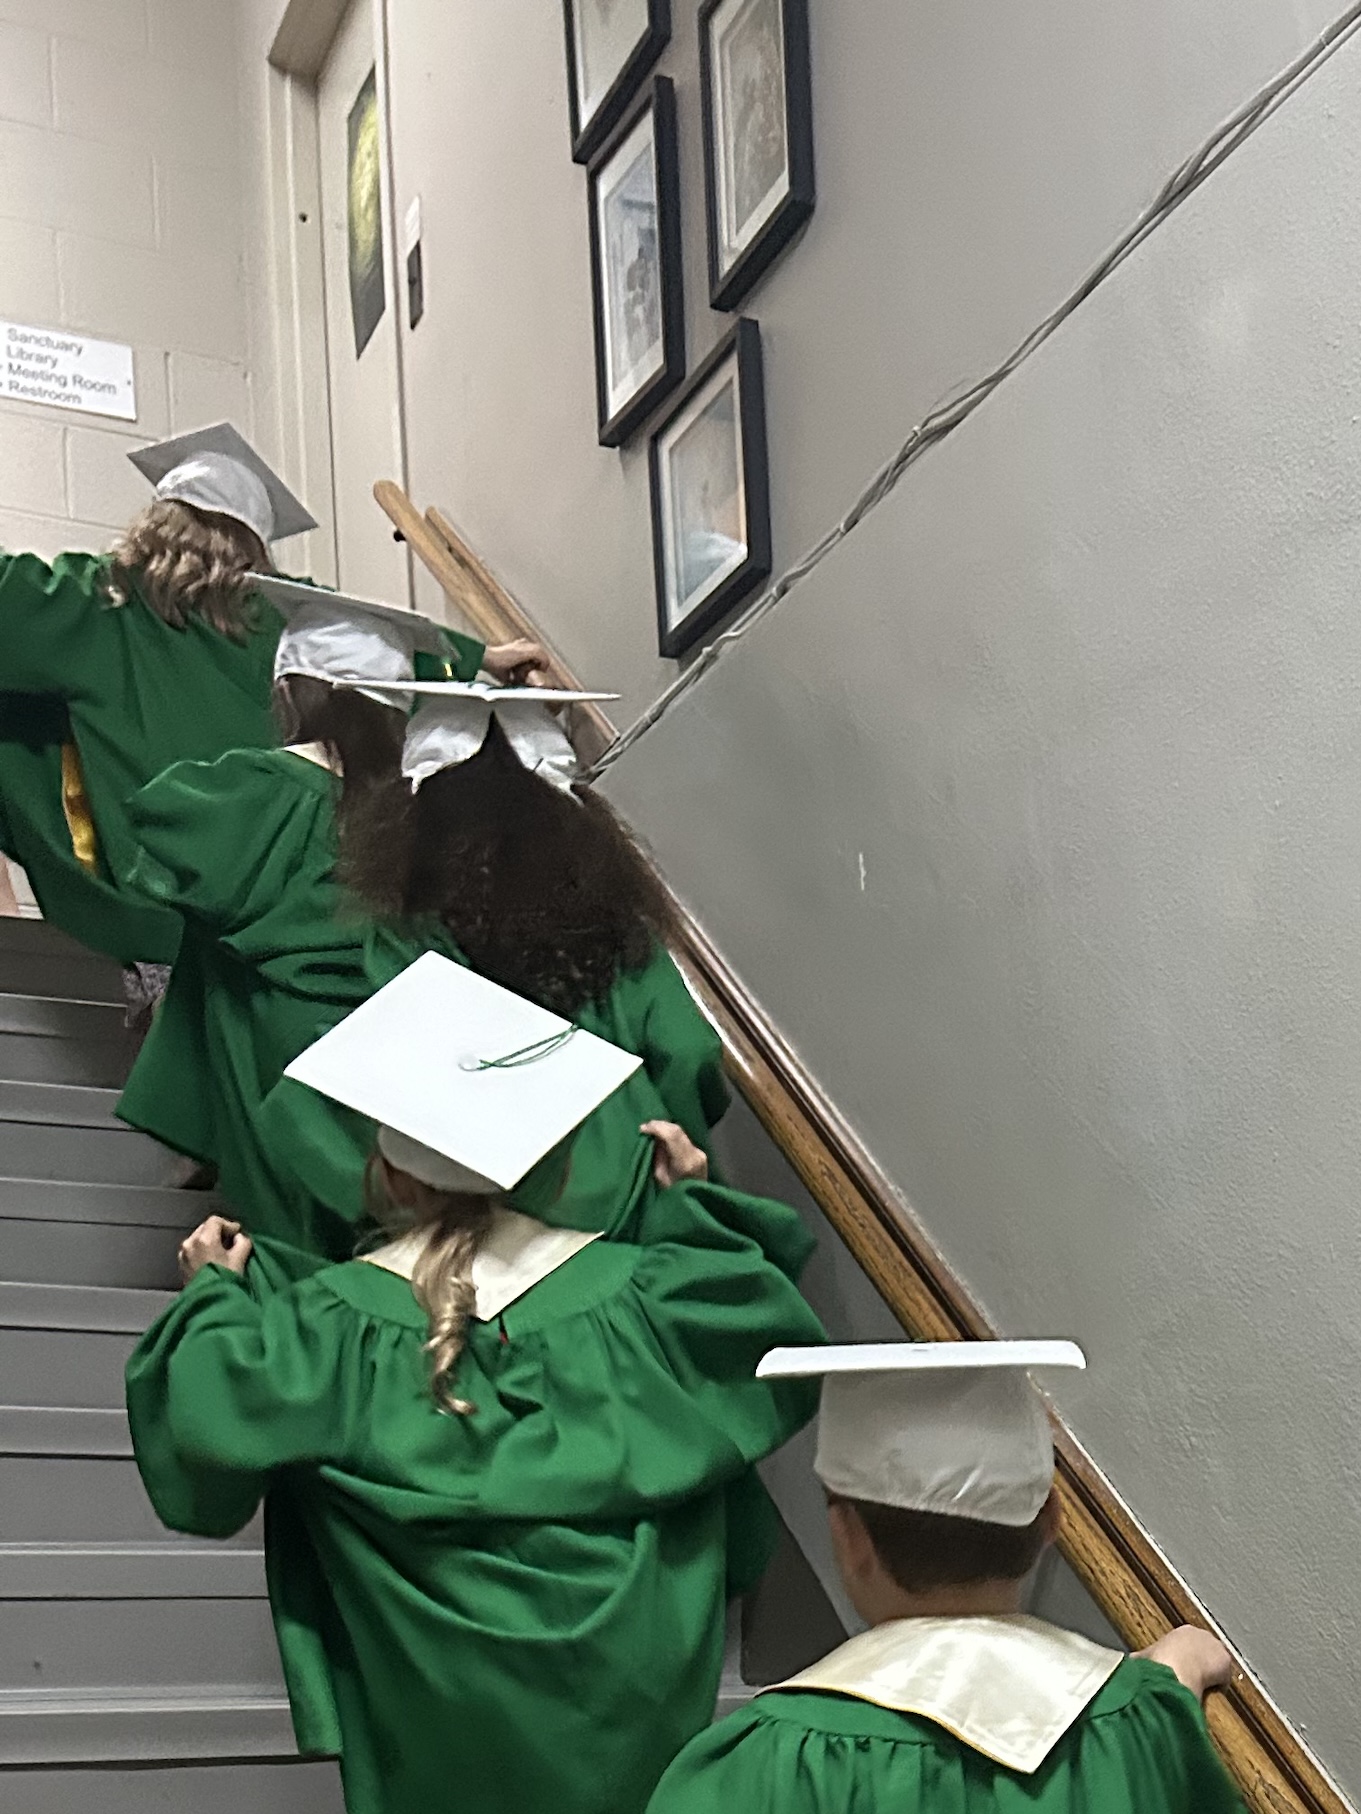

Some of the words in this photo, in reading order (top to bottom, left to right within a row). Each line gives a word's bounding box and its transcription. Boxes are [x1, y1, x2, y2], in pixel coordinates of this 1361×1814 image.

[7, 327, 83, 356] Sanctuary
[6, 345, 58, 369] Library
[8, 362, 68, 388] Meeting
[72, 374, 117, 394] Room
[8, 380, 82, 404] Restroom
